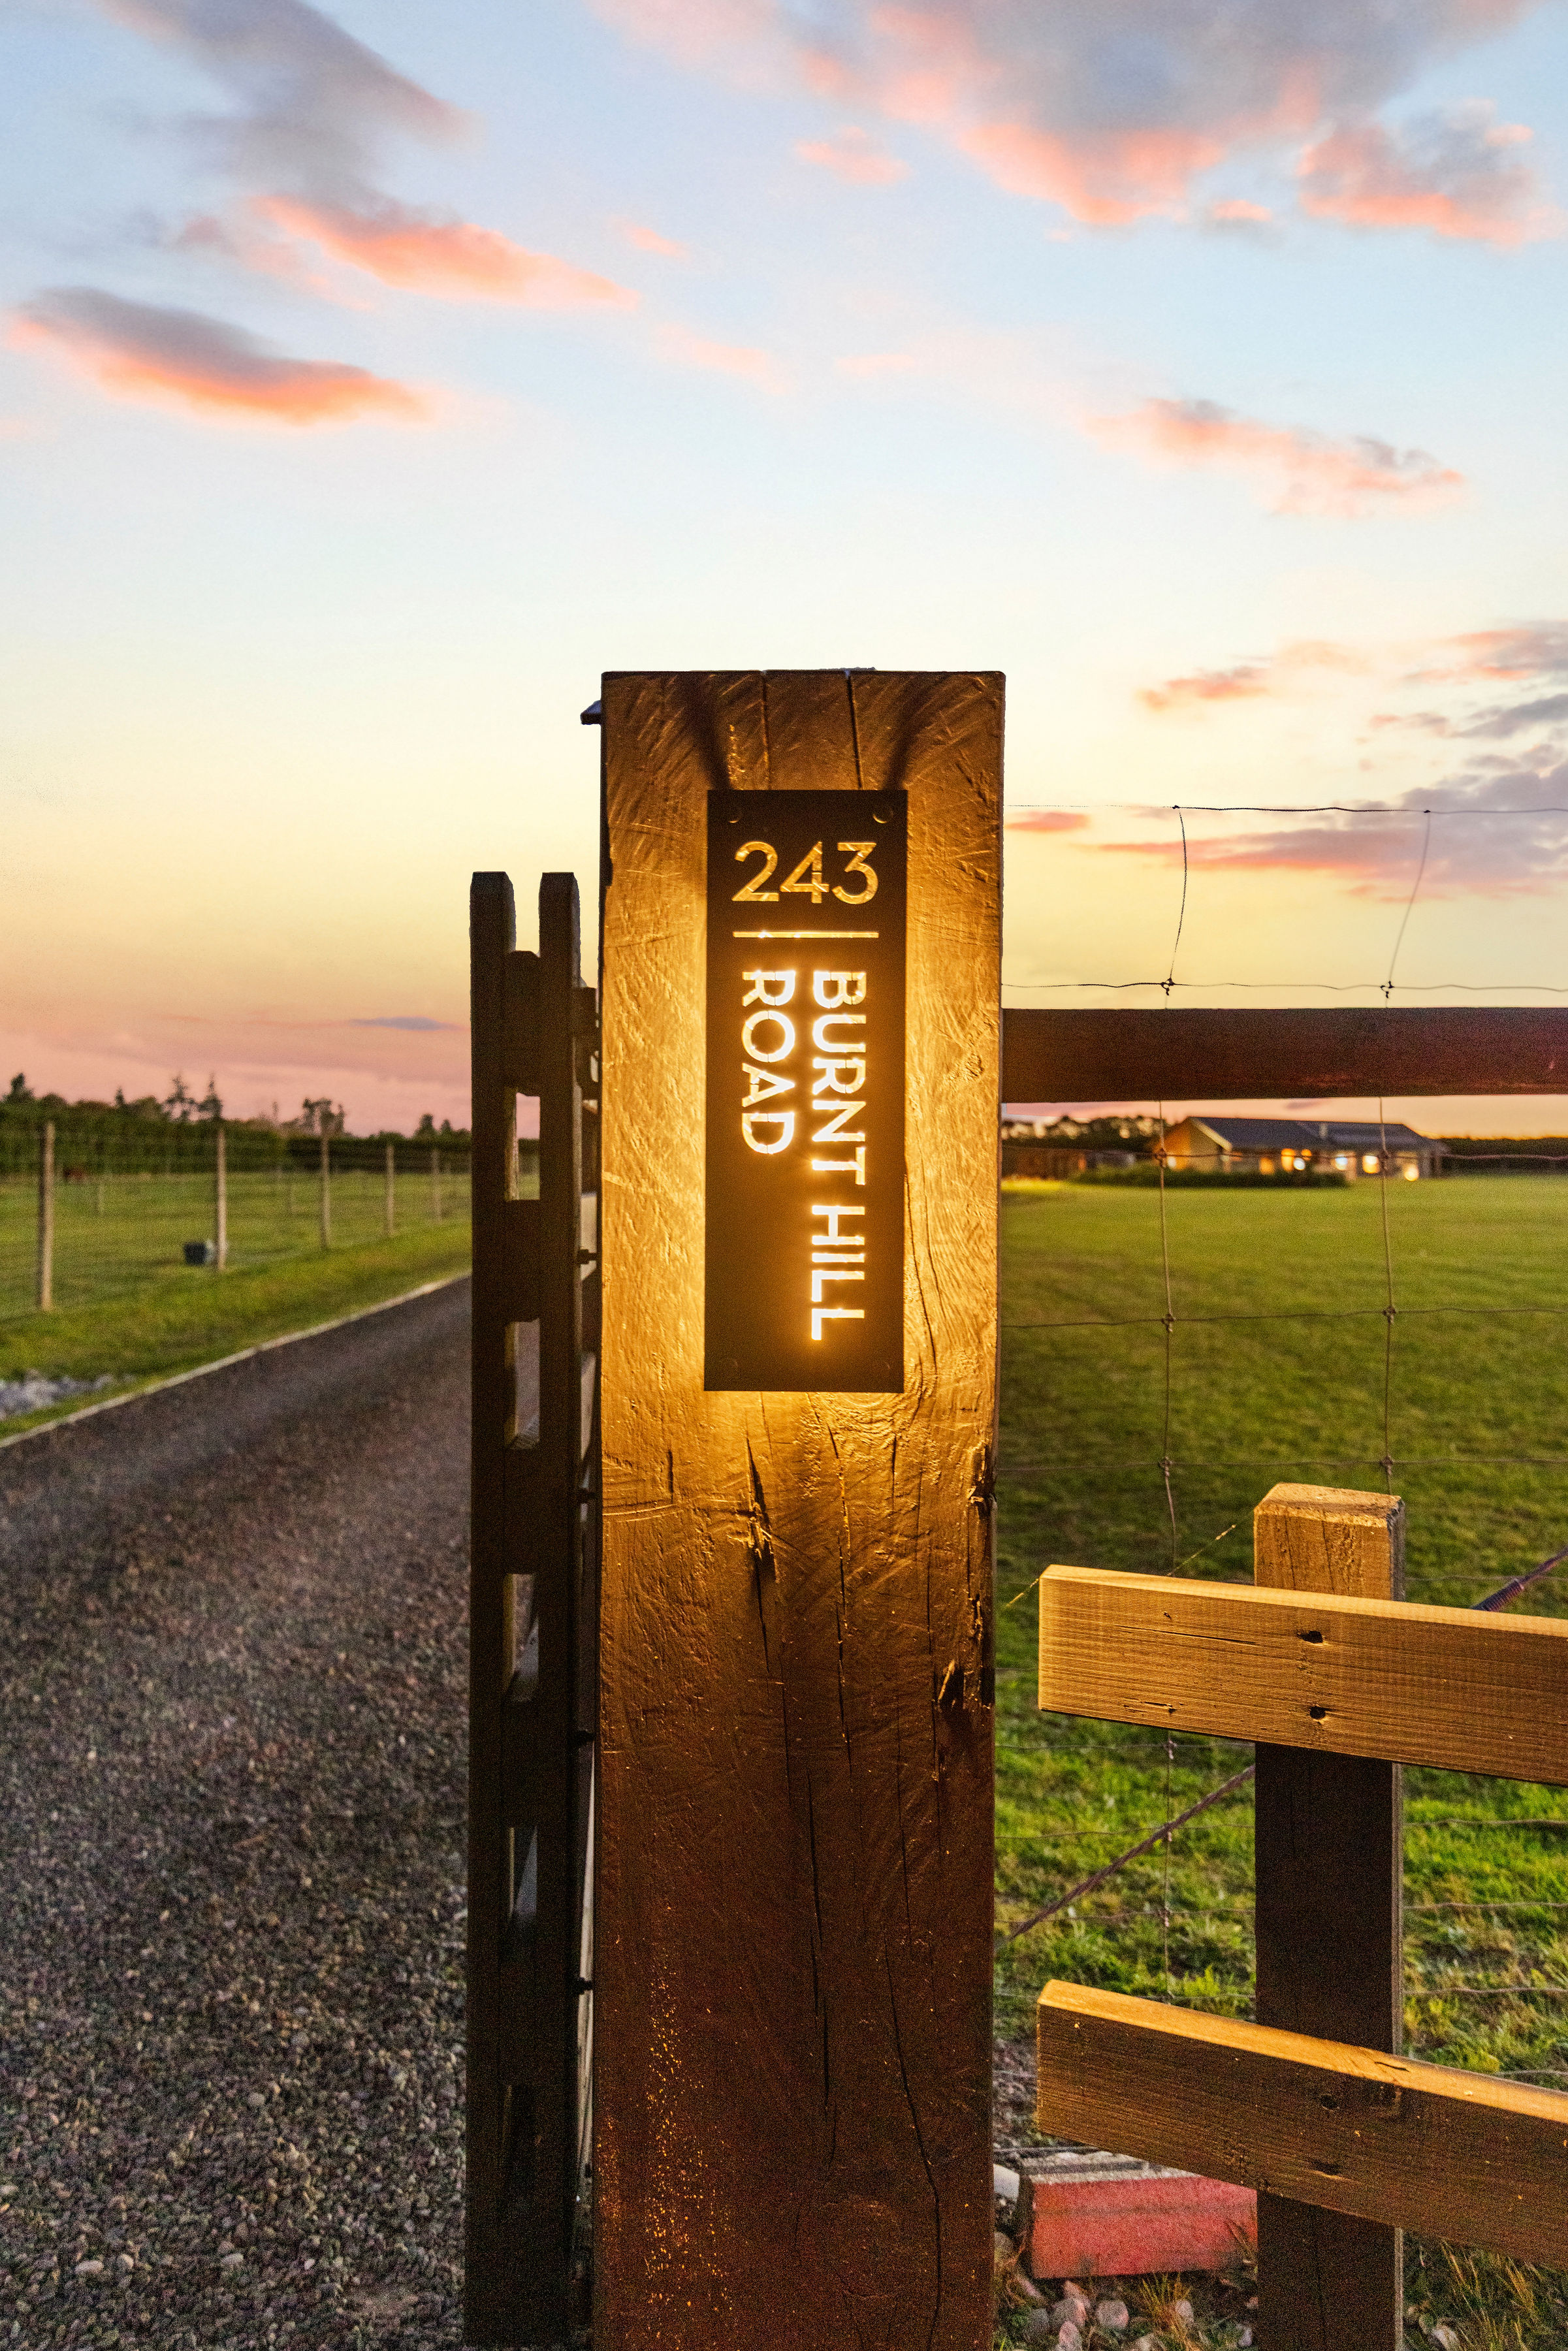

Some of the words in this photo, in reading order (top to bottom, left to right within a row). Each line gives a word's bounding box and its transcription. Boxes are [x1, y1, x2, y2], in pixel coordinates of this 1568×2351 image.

[731, 841, 879, 904] 243
[741, 970, 796, 1155] ROAD
[812, 970, 866, 1185] BURNT
[810, 1205, 865, 1341] HILL
